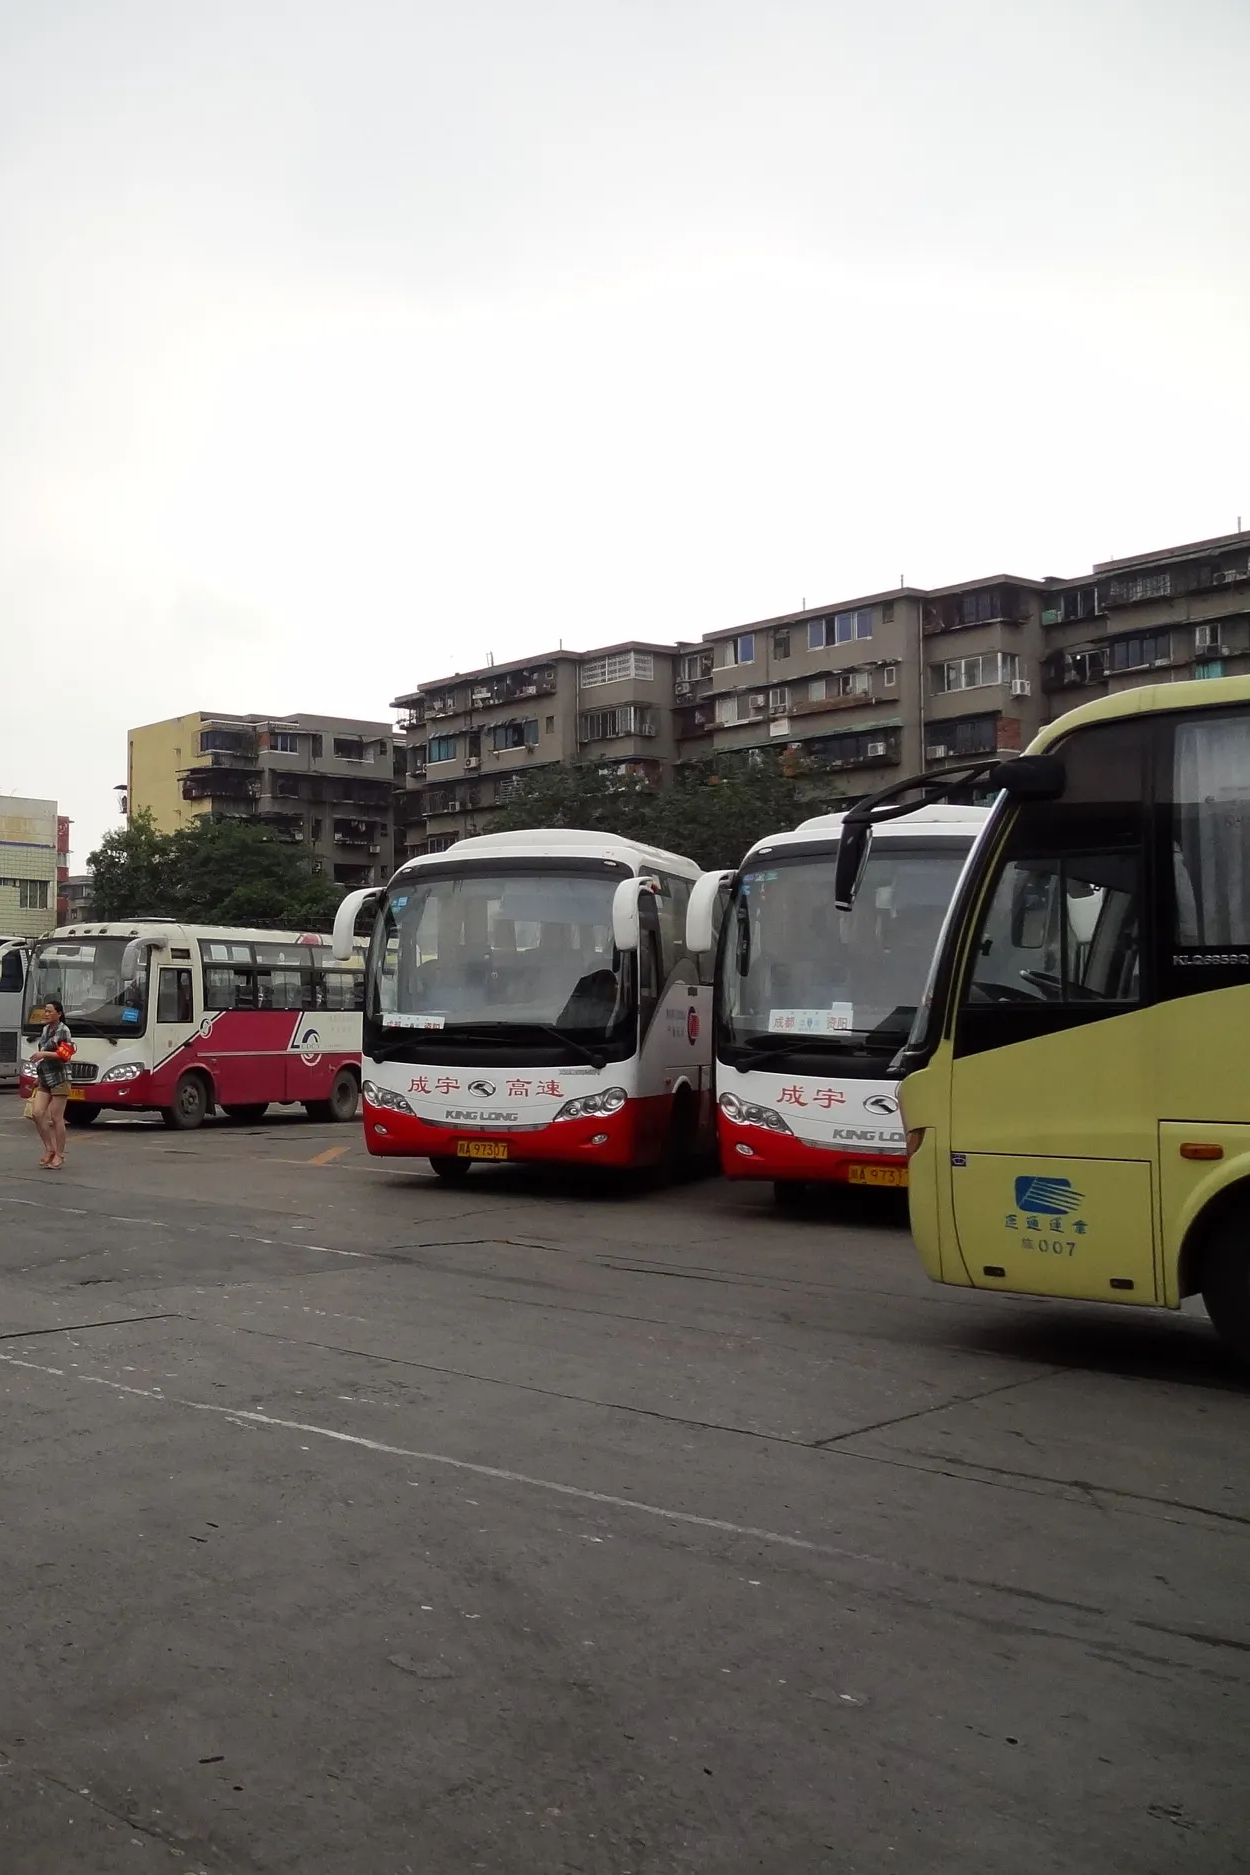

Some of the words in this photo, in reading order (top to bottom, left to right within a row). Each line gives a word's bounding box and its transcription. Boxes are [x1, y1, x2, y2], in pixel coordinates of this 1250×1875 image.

[407, 1076, 461, 1095] 成宇
[506, 1079, 565, 1098] 高速
[776, 1085, 846, 1109] 成宇
[445, 1110, 478, 1121] KING
[480, 1111, 518, 1122] LONG
[832, 1128, 876, 1141] KING
[878, 1132, 907, 1143] LO
